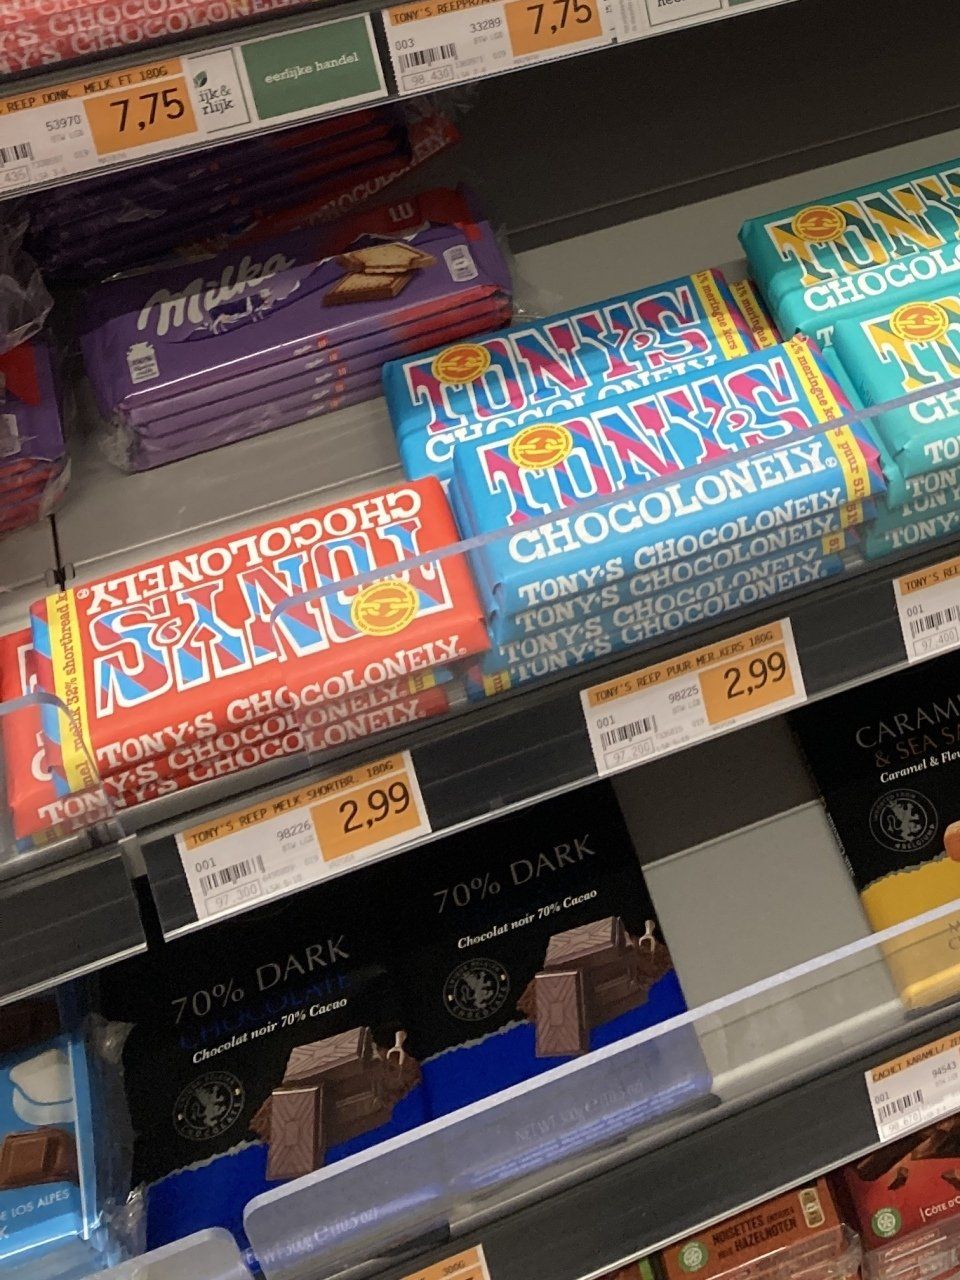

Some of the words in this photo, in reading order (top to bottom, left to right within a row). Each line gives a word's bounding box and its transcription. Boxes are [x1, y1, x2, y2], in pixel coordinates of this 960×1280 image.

[469, 17, 502, 34] 33289
[264, 65, 314, 84] eerlijke
[315, 53, 359, 72] handel
[45, 115, 82, 132] 53970
[110, 88, 185, 134] 7,75
[136, 253, 297, 336] Milka
[799, 353, 833, 403] meringue
[476, 358, 814, 527] TONY'S
[508, 442, 829, 566] CHOCOLONELY
[83, 488, 423, 617] CHOCOLONELY
[91, 517, 455, 718] TONY'S
[595, 681, 631, 702] TONY'S
[667, 661, 691, 677] PUUR
[668, 685, 699, 703] 98225
[723, 651, 787, 700] 2,99
[879, 761, 927, 784] Caramel
[929, 756, 939, 766] &
[895, 734, 937, 759] SEA
[190, 819, 234, 845] TONY'S
[272, 797, 301, 815] MELK
[366, 760, 394, 778] 180G
[339, 781, 410, 834] 2,99
[276, 820, 312, 841] 98226
[194, 857, 217, 873] 001
[433, 872, 501, 914] 70%
[510, 833, 595, 885] DARK
[170, 973, 244, 1023] 70%
[254, 935, 351, 989] DARK
[192, 1037, 245, 1064] Chocolat
[245, 1025, 278, 1047] noir
[280, 1010, 306, 1030] 70%
[308, 997, 348, 1020] Cacao
[37, 1189, 70, 1209] ALPES
